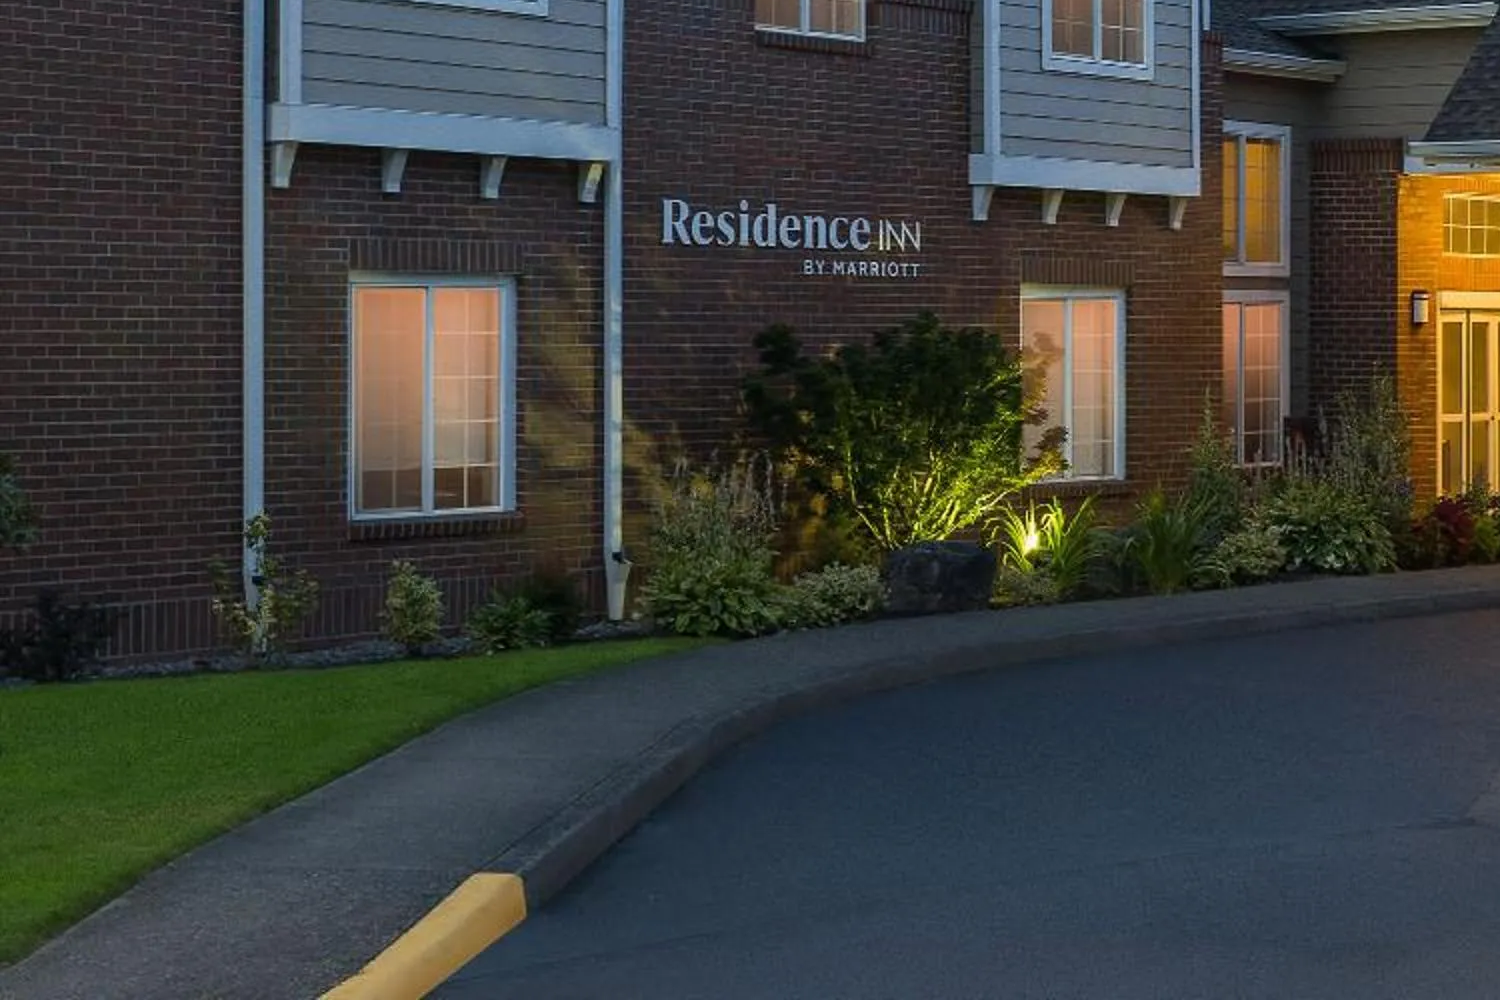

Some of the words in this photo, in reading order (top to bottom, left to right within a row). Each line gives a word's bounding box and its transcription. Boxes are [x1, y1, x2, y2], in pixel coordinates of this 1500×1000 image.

[662, 199, 872, 250] Residence
[878, 219, 922, 251] INN
[803, 259, 825, 275] BY
[832, 260, 921, 277] MARRIOTT
